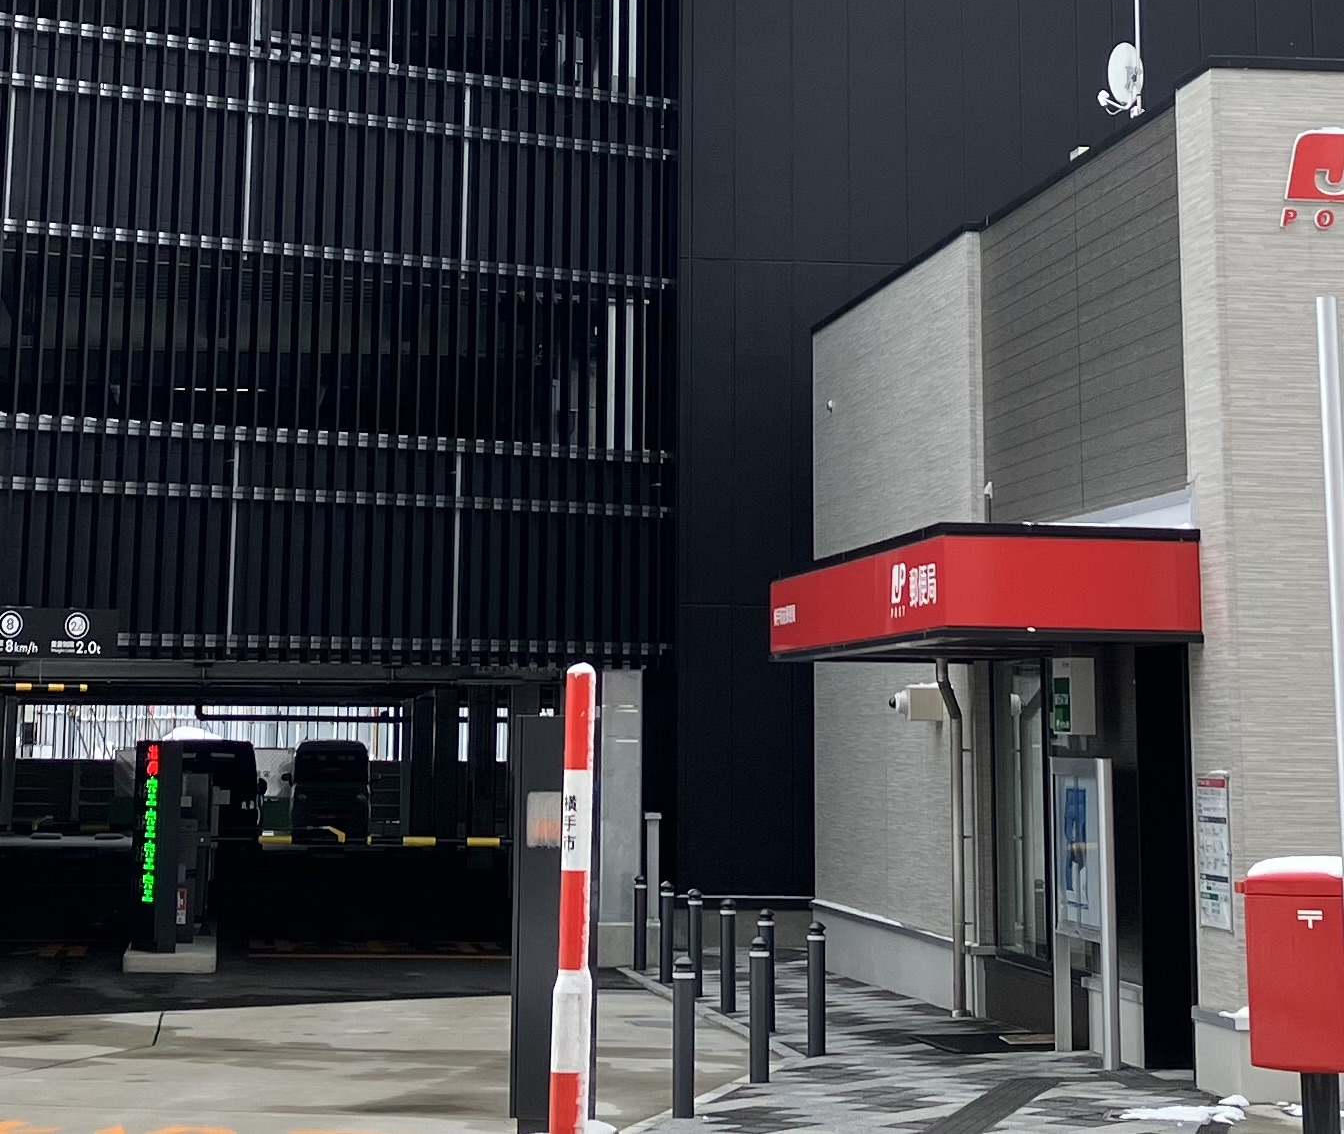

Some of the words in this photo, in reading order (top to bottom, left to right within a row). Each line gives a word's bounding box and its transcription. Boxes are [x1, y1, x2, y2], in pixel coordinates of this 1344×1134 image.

[6, 618, 14, 630] 8
[5, 639, 39, 654] 8km/h
[76, 641, 101, 654] 2.0t
[563, 794, 577, 852] 横手市
